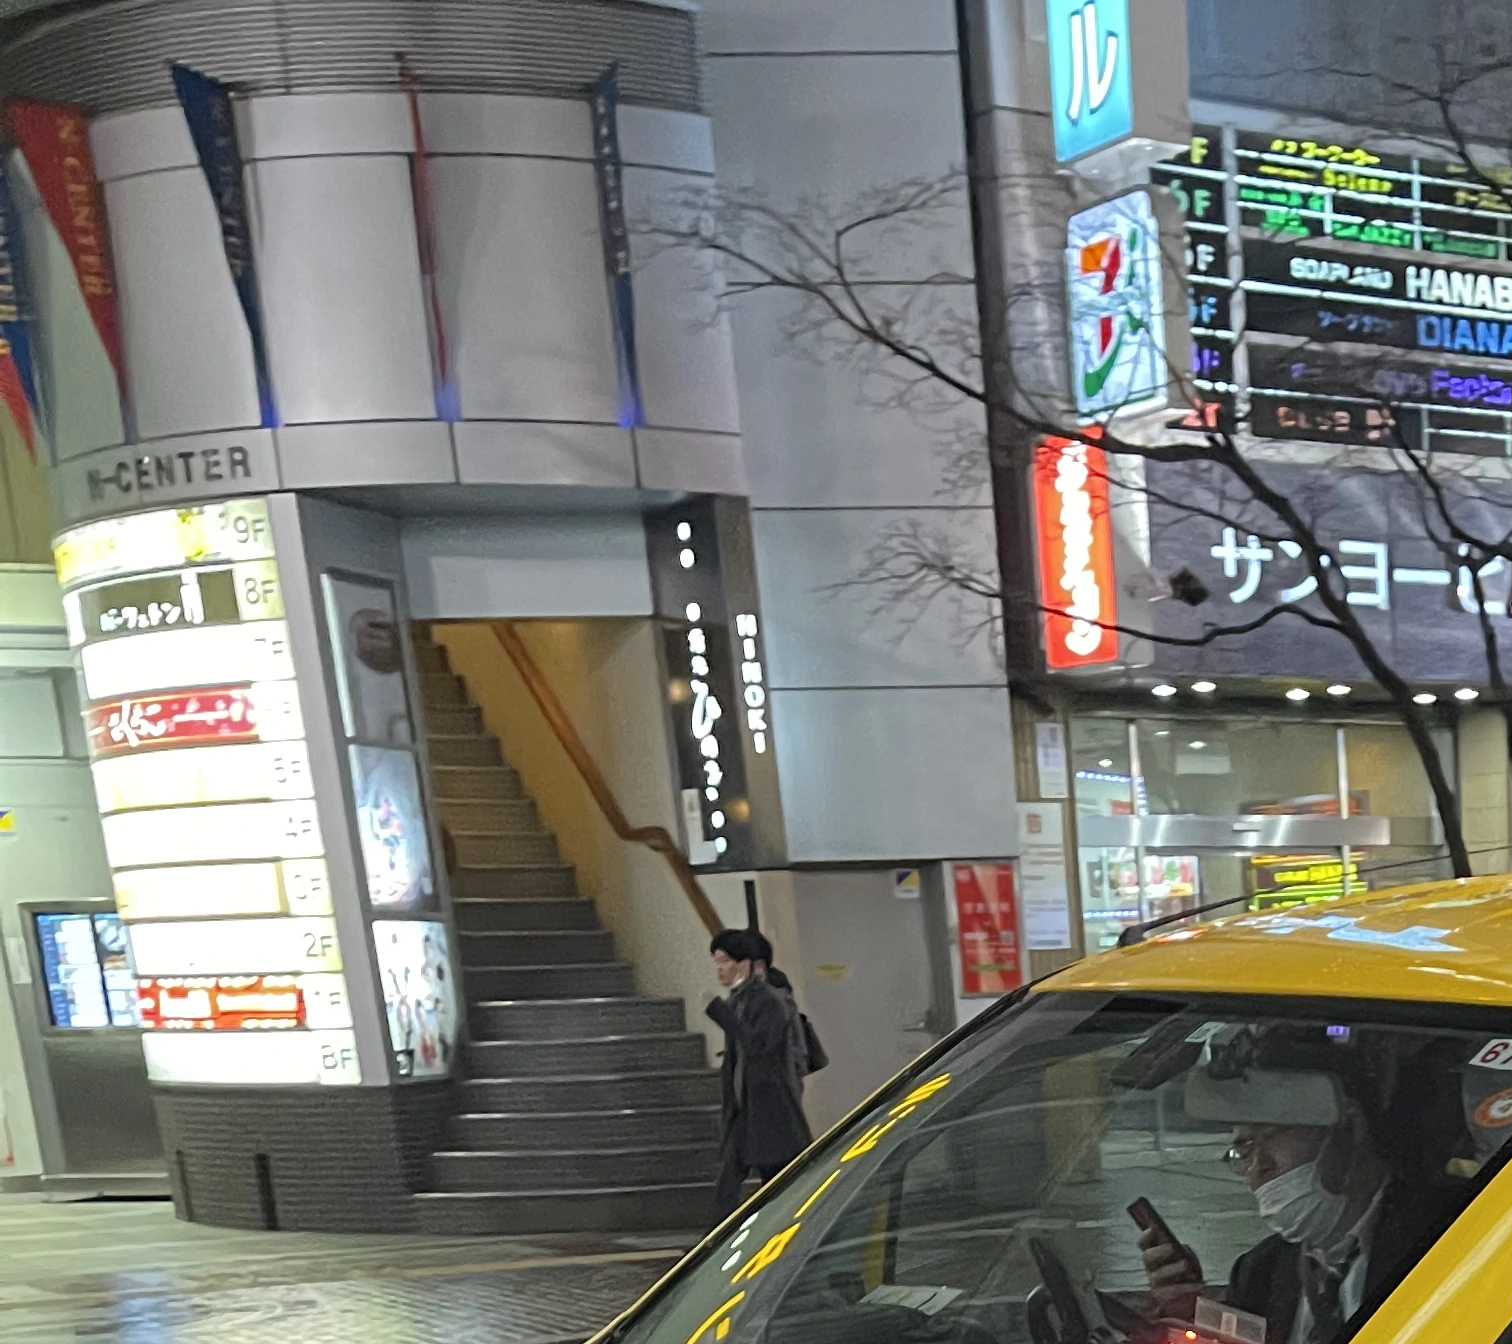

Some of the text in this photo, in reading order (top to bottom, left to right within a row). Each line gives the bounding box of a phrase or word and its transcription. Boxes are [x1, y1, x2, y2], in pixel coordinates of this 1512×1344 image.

[1067, 1, 1118, 125] ル
[233, 514, 265, 543] 9F
[245, 577, 277, 605] 8F
[303, 932, 333, 958] 2F
